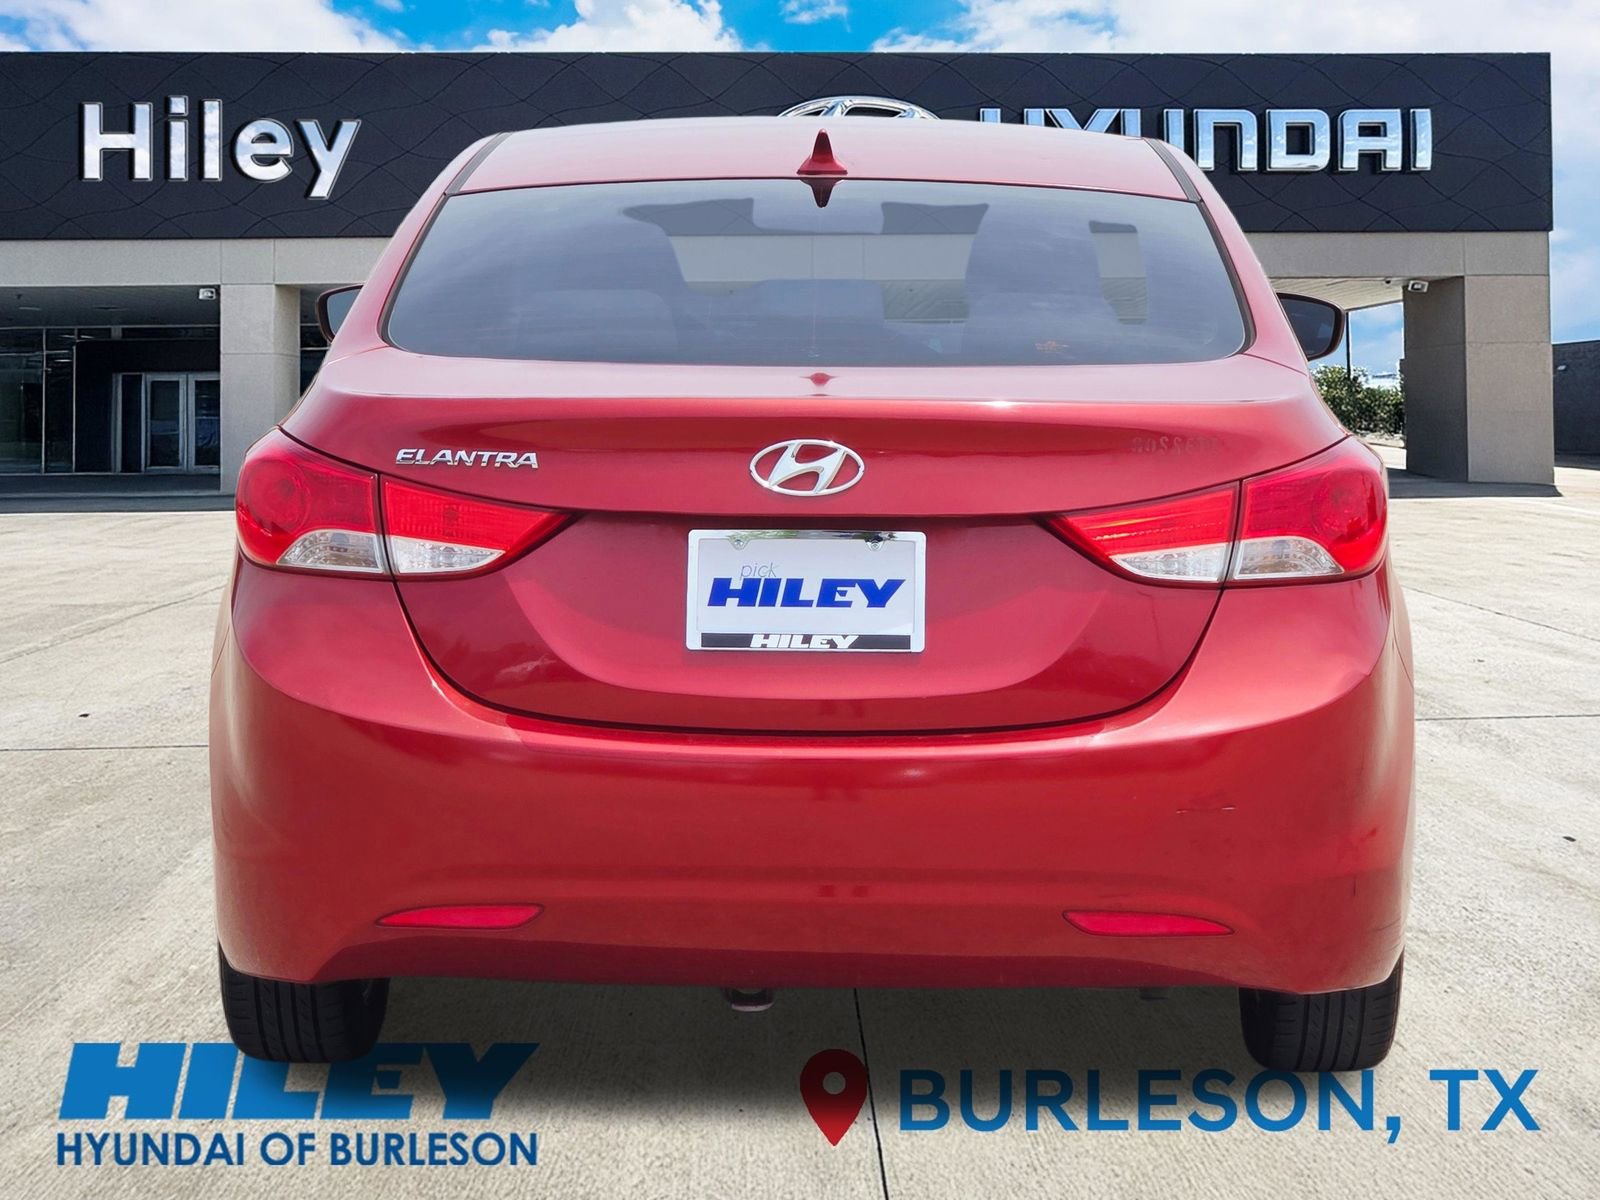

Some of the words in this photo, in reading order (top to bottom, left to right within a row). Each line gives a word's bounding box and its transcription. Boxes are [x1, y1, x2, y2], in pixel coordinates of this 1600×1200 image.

[80, 95, 362, 200] Hiley
[395, 448, 539, 469] ELANTRA
[740, 562, 778, 578] pick
[707, 577, 906, 608] HILEY
[749, 634, 859, 649] HILEY
